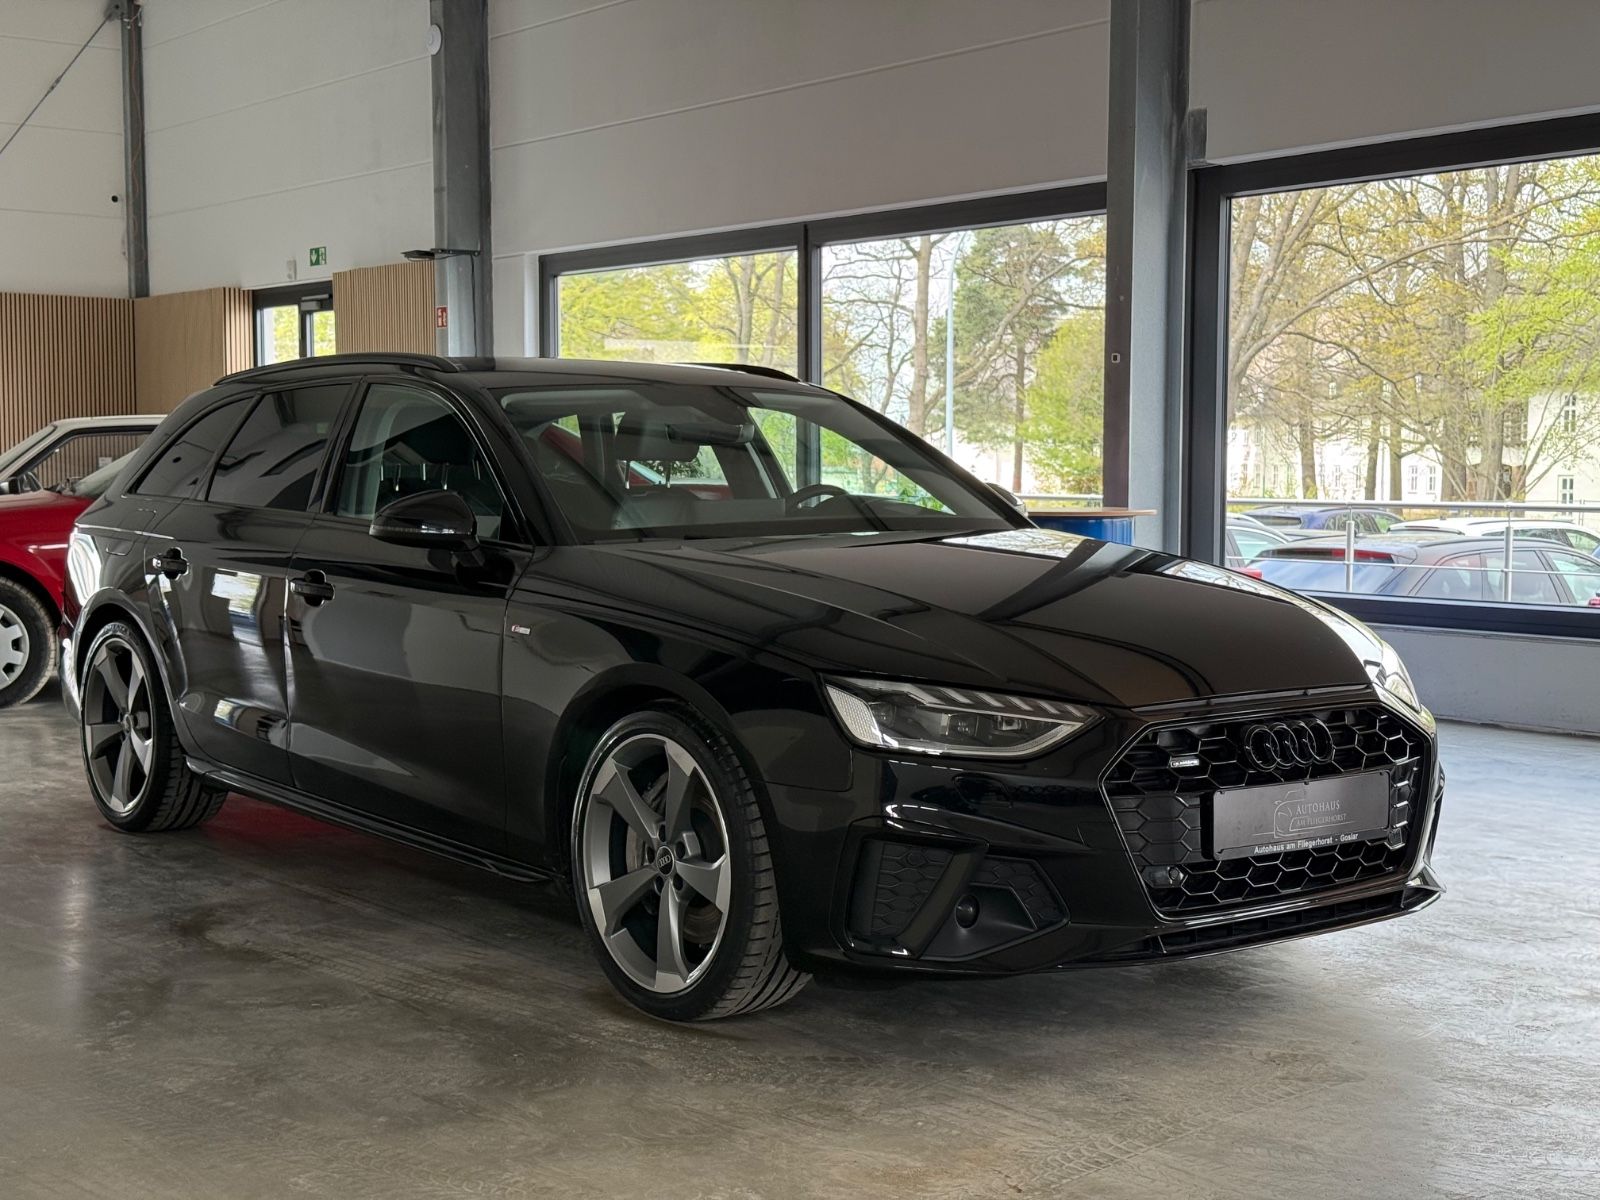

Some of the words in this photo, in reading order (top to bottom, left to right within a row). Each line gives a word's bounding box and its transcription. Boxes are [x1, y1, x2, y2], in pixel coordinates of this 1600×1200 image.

[1296, 800, 1340, 815] AUTOHAUS
[1254, 842, 1285, 854] Autohaus
[1286, 842, 1296, 850] am
[1297, 837, 1333, 848] Fliegerhorst
[1340, 833, 1358, 842] Goslar
